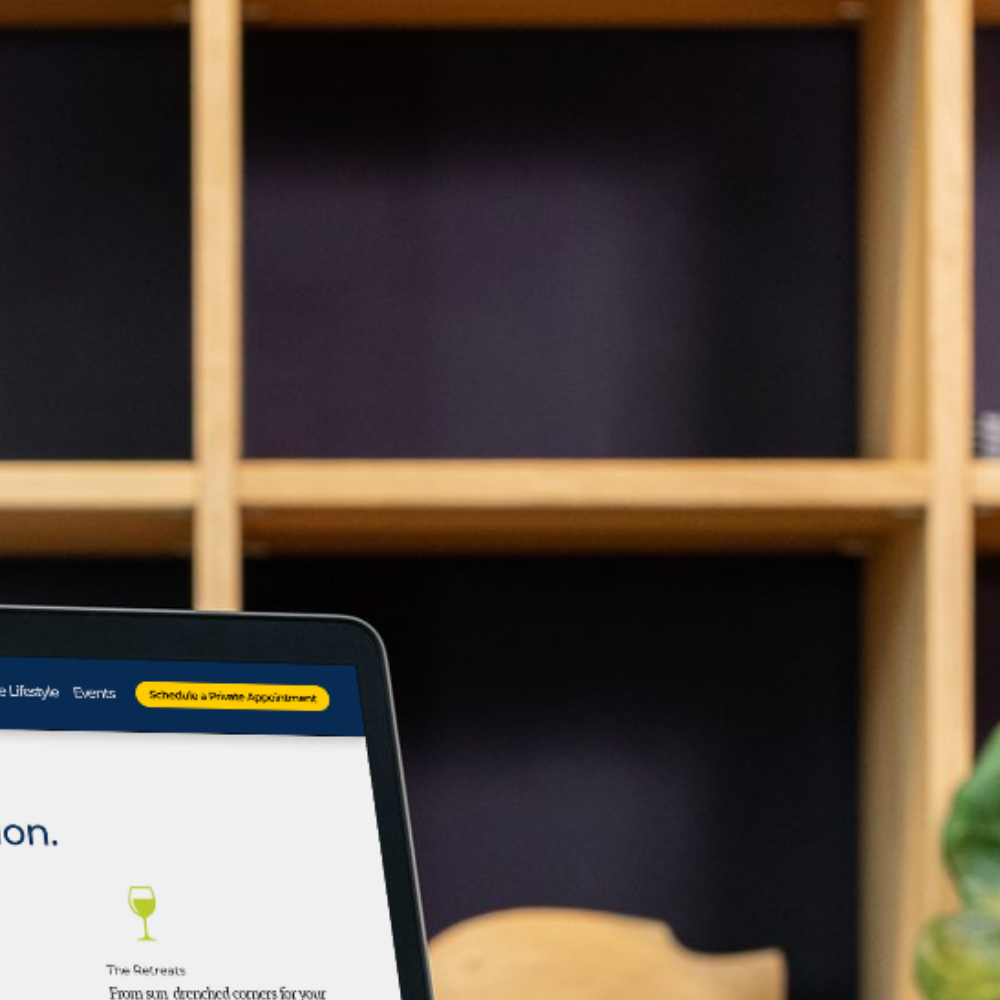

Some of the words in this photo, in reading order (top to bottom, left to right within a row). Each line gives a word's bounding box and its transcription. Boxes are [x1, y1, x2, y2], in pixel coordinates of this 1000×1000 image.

[9, 685, 59, 700] Lifestyle
[73, 687, 116, 698] Events
[150, 690, 198, 700] Schedule
[209, 691, 244, 701] Private
[247, 693, 317, 703] Appointment
[106, 965, 130, 975] The
[133, 965, 185, 976] Retreats
[109, 987, 143, 1000] From
[232, 990, 277, 1000] corners
[280, 987, 296, 1000] for
